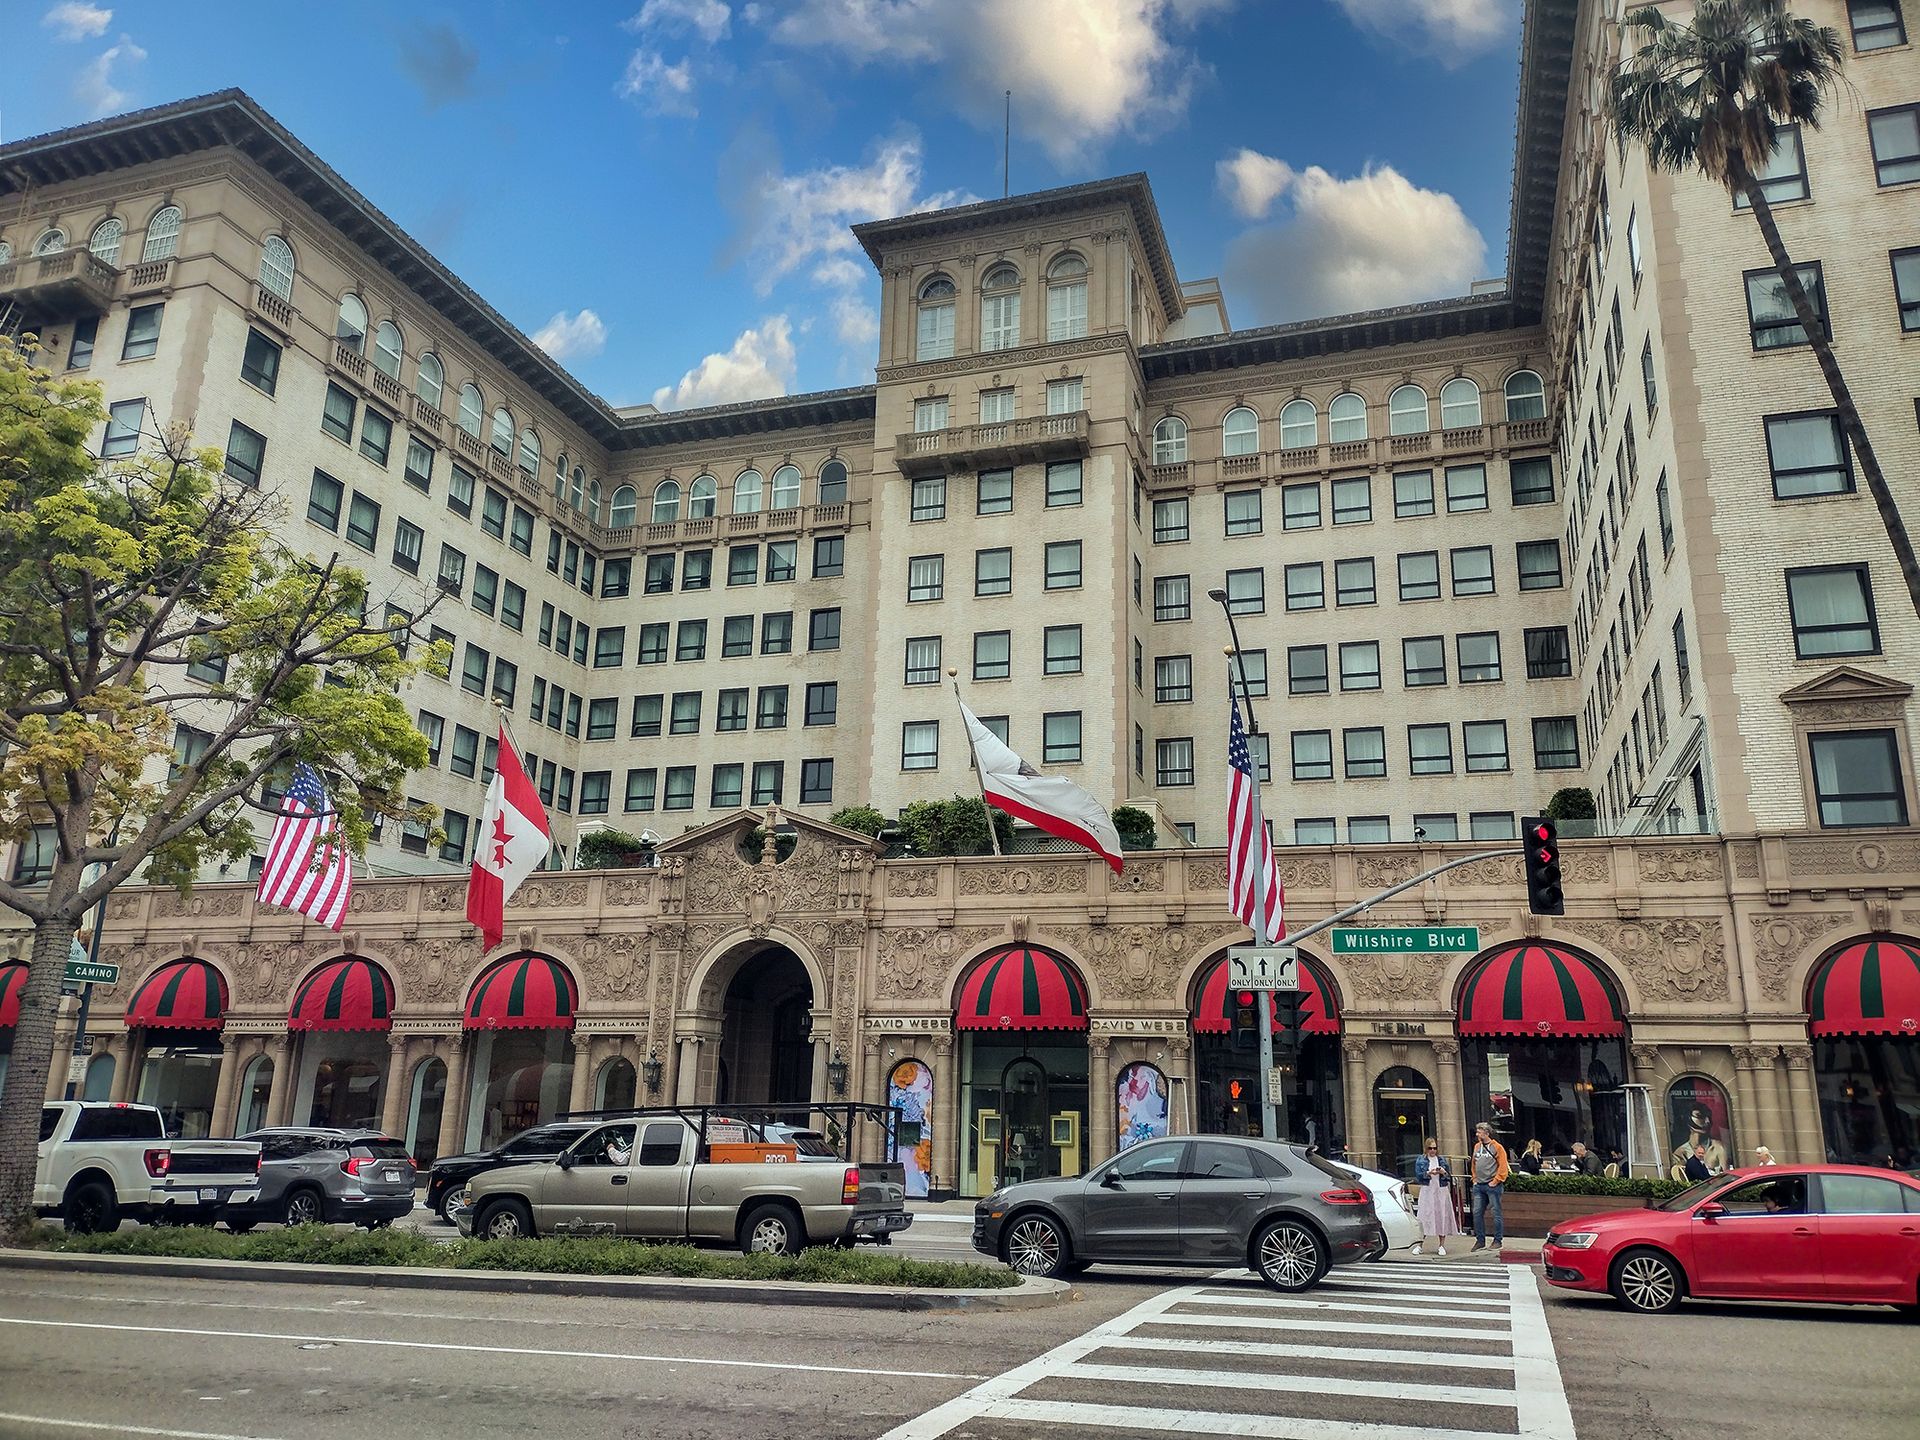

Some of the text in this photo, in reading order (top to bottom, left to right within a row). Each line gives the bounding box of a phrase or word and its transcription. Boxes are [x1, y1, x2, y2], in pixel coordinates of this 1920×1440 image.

[1345, 933, 1466, 948] Wilshire Blvd
[75, 966, 112, 978] CAMINO
[1231, 979, 1251, 987] ONLY
[1254, 979, 1273, 987] ONLY
[1276, 979, 1296, 987] ONLY
[865, 1019, 949, 1029] DAVID WEBB
[1091, 1020, 1185, 1031] DAVID WEBB
[1371, 1022, 1426, 1035] THE Blvd
